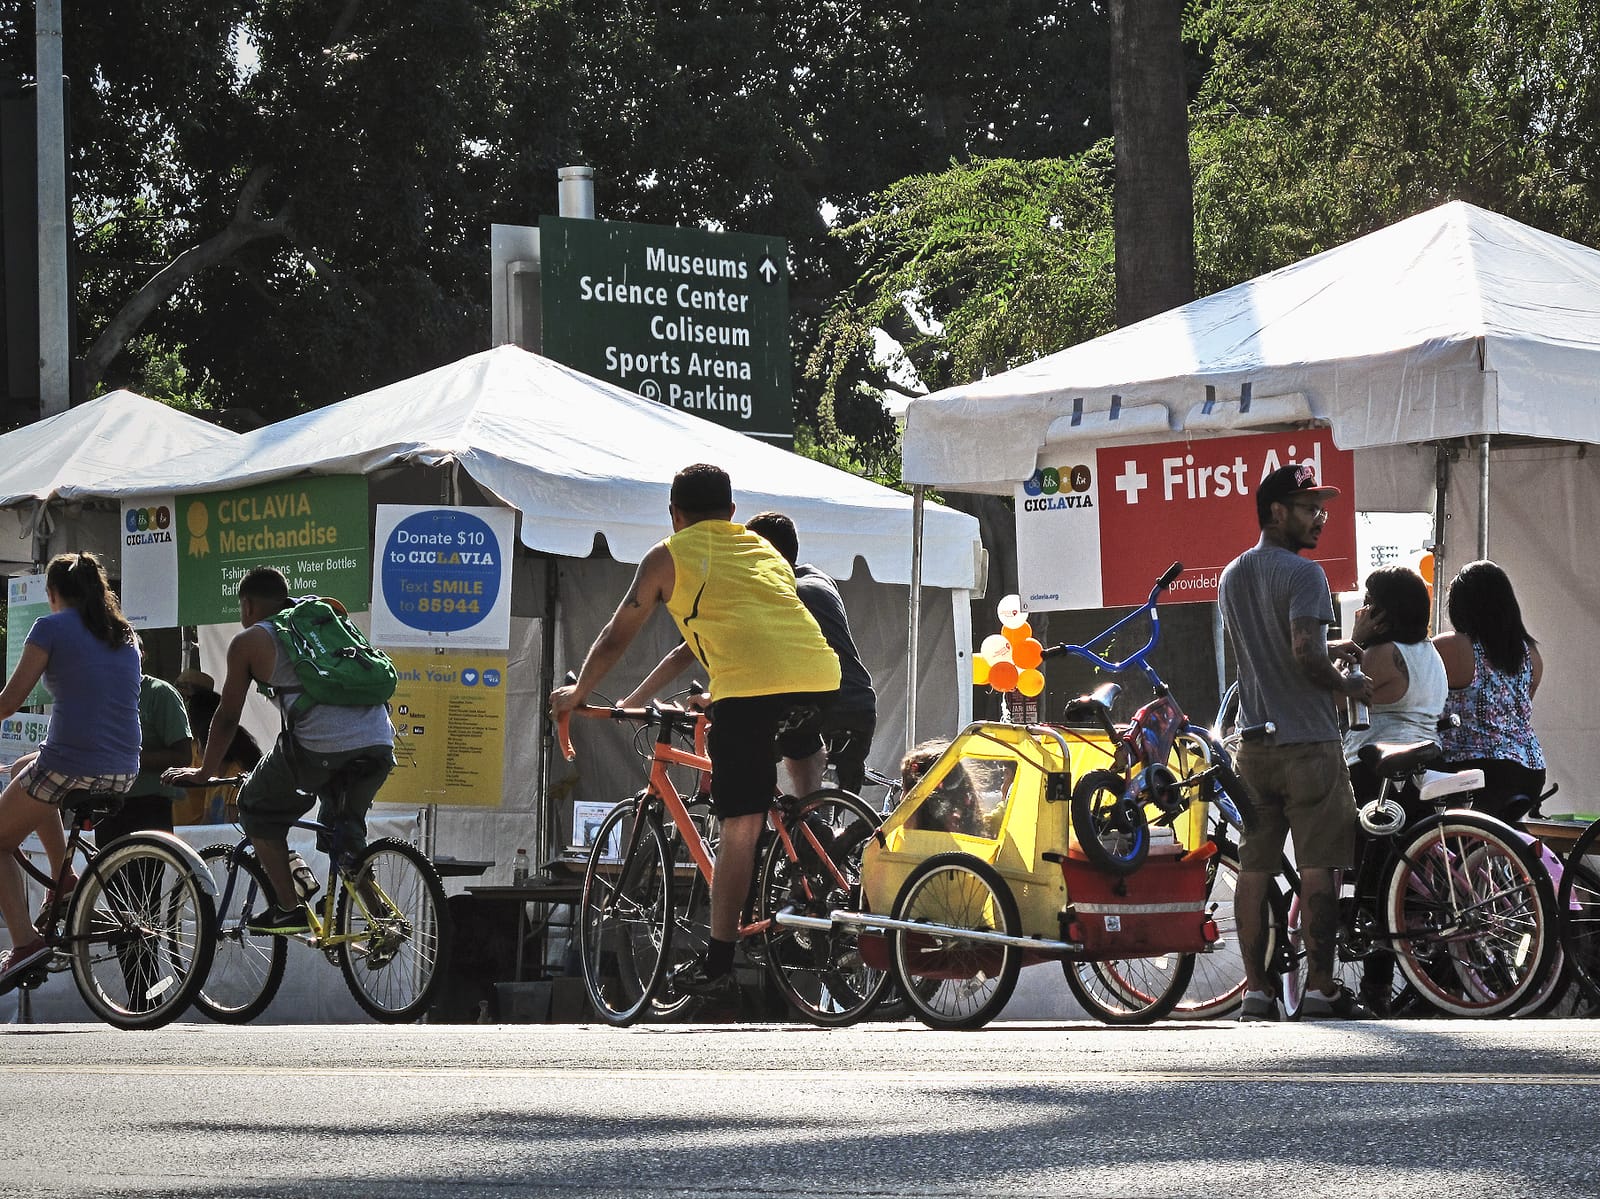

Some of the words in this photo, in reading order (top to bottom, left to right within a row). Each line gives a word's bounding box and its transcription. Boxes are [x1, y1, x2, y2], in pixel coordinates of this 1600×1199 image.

[646, 246, 748, 279] Museums
[579, 275, 667, 306] Science
[677, 283, 748, 313] Center
[650, 315, 750, 346] Coliseum
[605, 346, 680, 378] Sports
[688, 352, 751, 380] Arena
[669, 383, 752, 419] Parking
[1162, 453, 1249, 501] First
[218, 492, 311, 525] CICLAVIA
[1024, 494, 1093, 513] CICLAVIA
[126, 531, 172, 547] CICLAVIA
[219, 520, 337, 554] Merchandise
[397, 530, 452, 545] Donate
[457, 531, 485, 547] $10
[297, 559, 324, 573] Water
[326, 556, 357, 571] Bottles
[390, 551, 406, 563] to
[408, 551, 494, 566] CICLAVIA
[221, 582, 240, 596] Raff
[294, 578, 317, 590] More
[400, 579, 428, 593] Text
[432, 580, 483, 595] SMILE
[1168, 572, 1218, 595] provided
[400, 600, 414, 612] to
[418, 598, 480, 613] 85944
[425, 670, 457, 683] You!
[24, 721, 38, 743] $5
